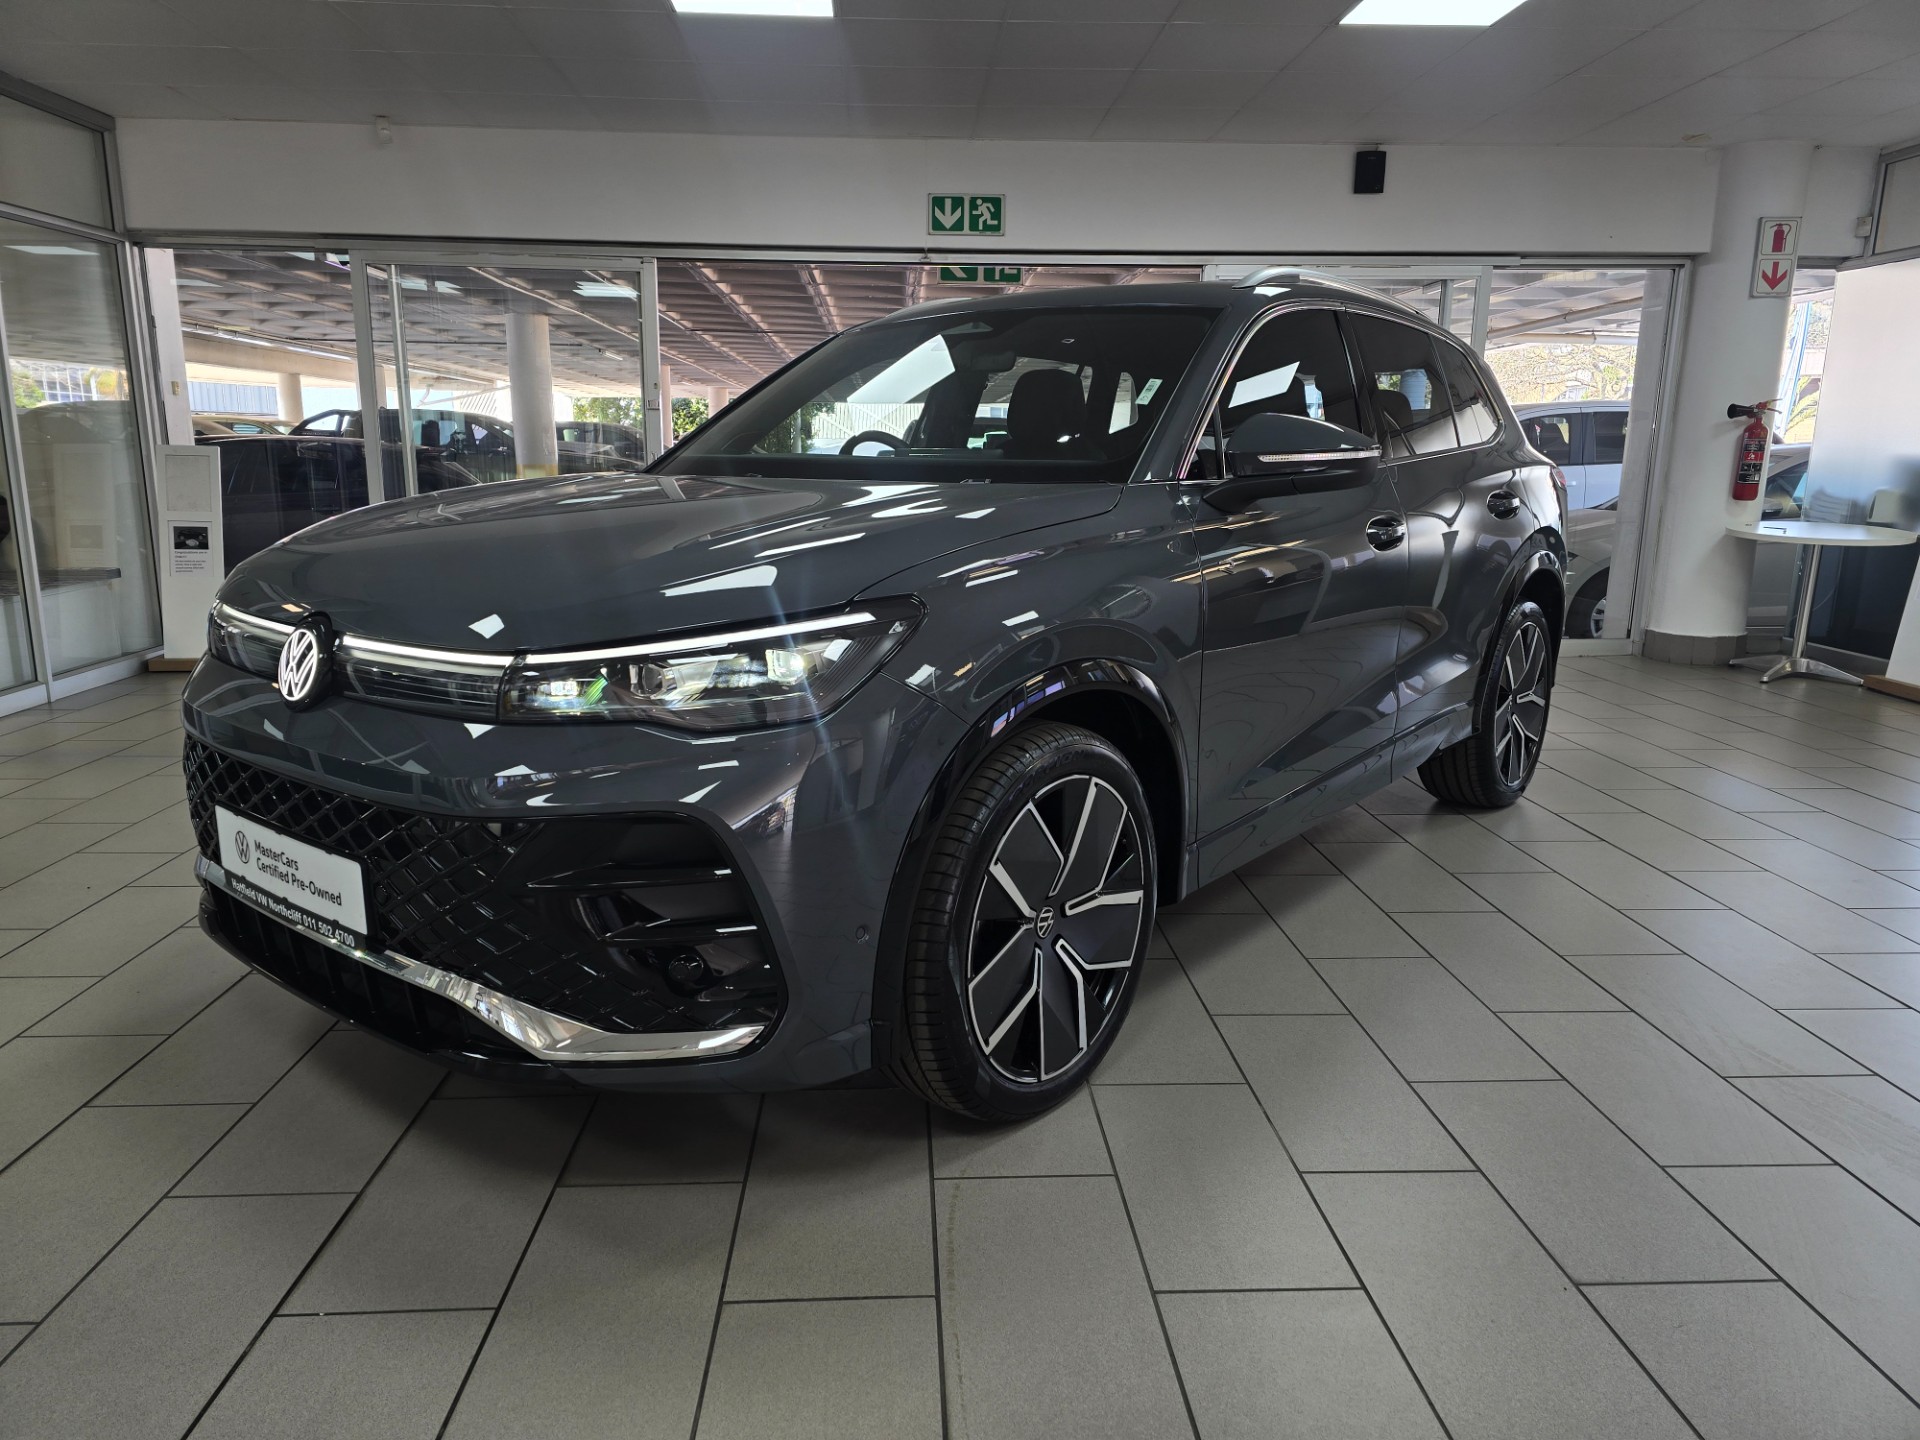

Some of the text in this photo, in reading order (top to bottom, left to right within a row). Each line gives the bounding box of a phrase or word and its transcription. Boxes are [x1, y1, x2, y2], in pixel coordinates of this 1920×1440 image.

[254, 839, 299, 871] MasterCars
[256, 857, 342, 906] Certified Pre-Owned
[231, 877, 355, 947] Hatfield VW Northcliff 011 502 4700
